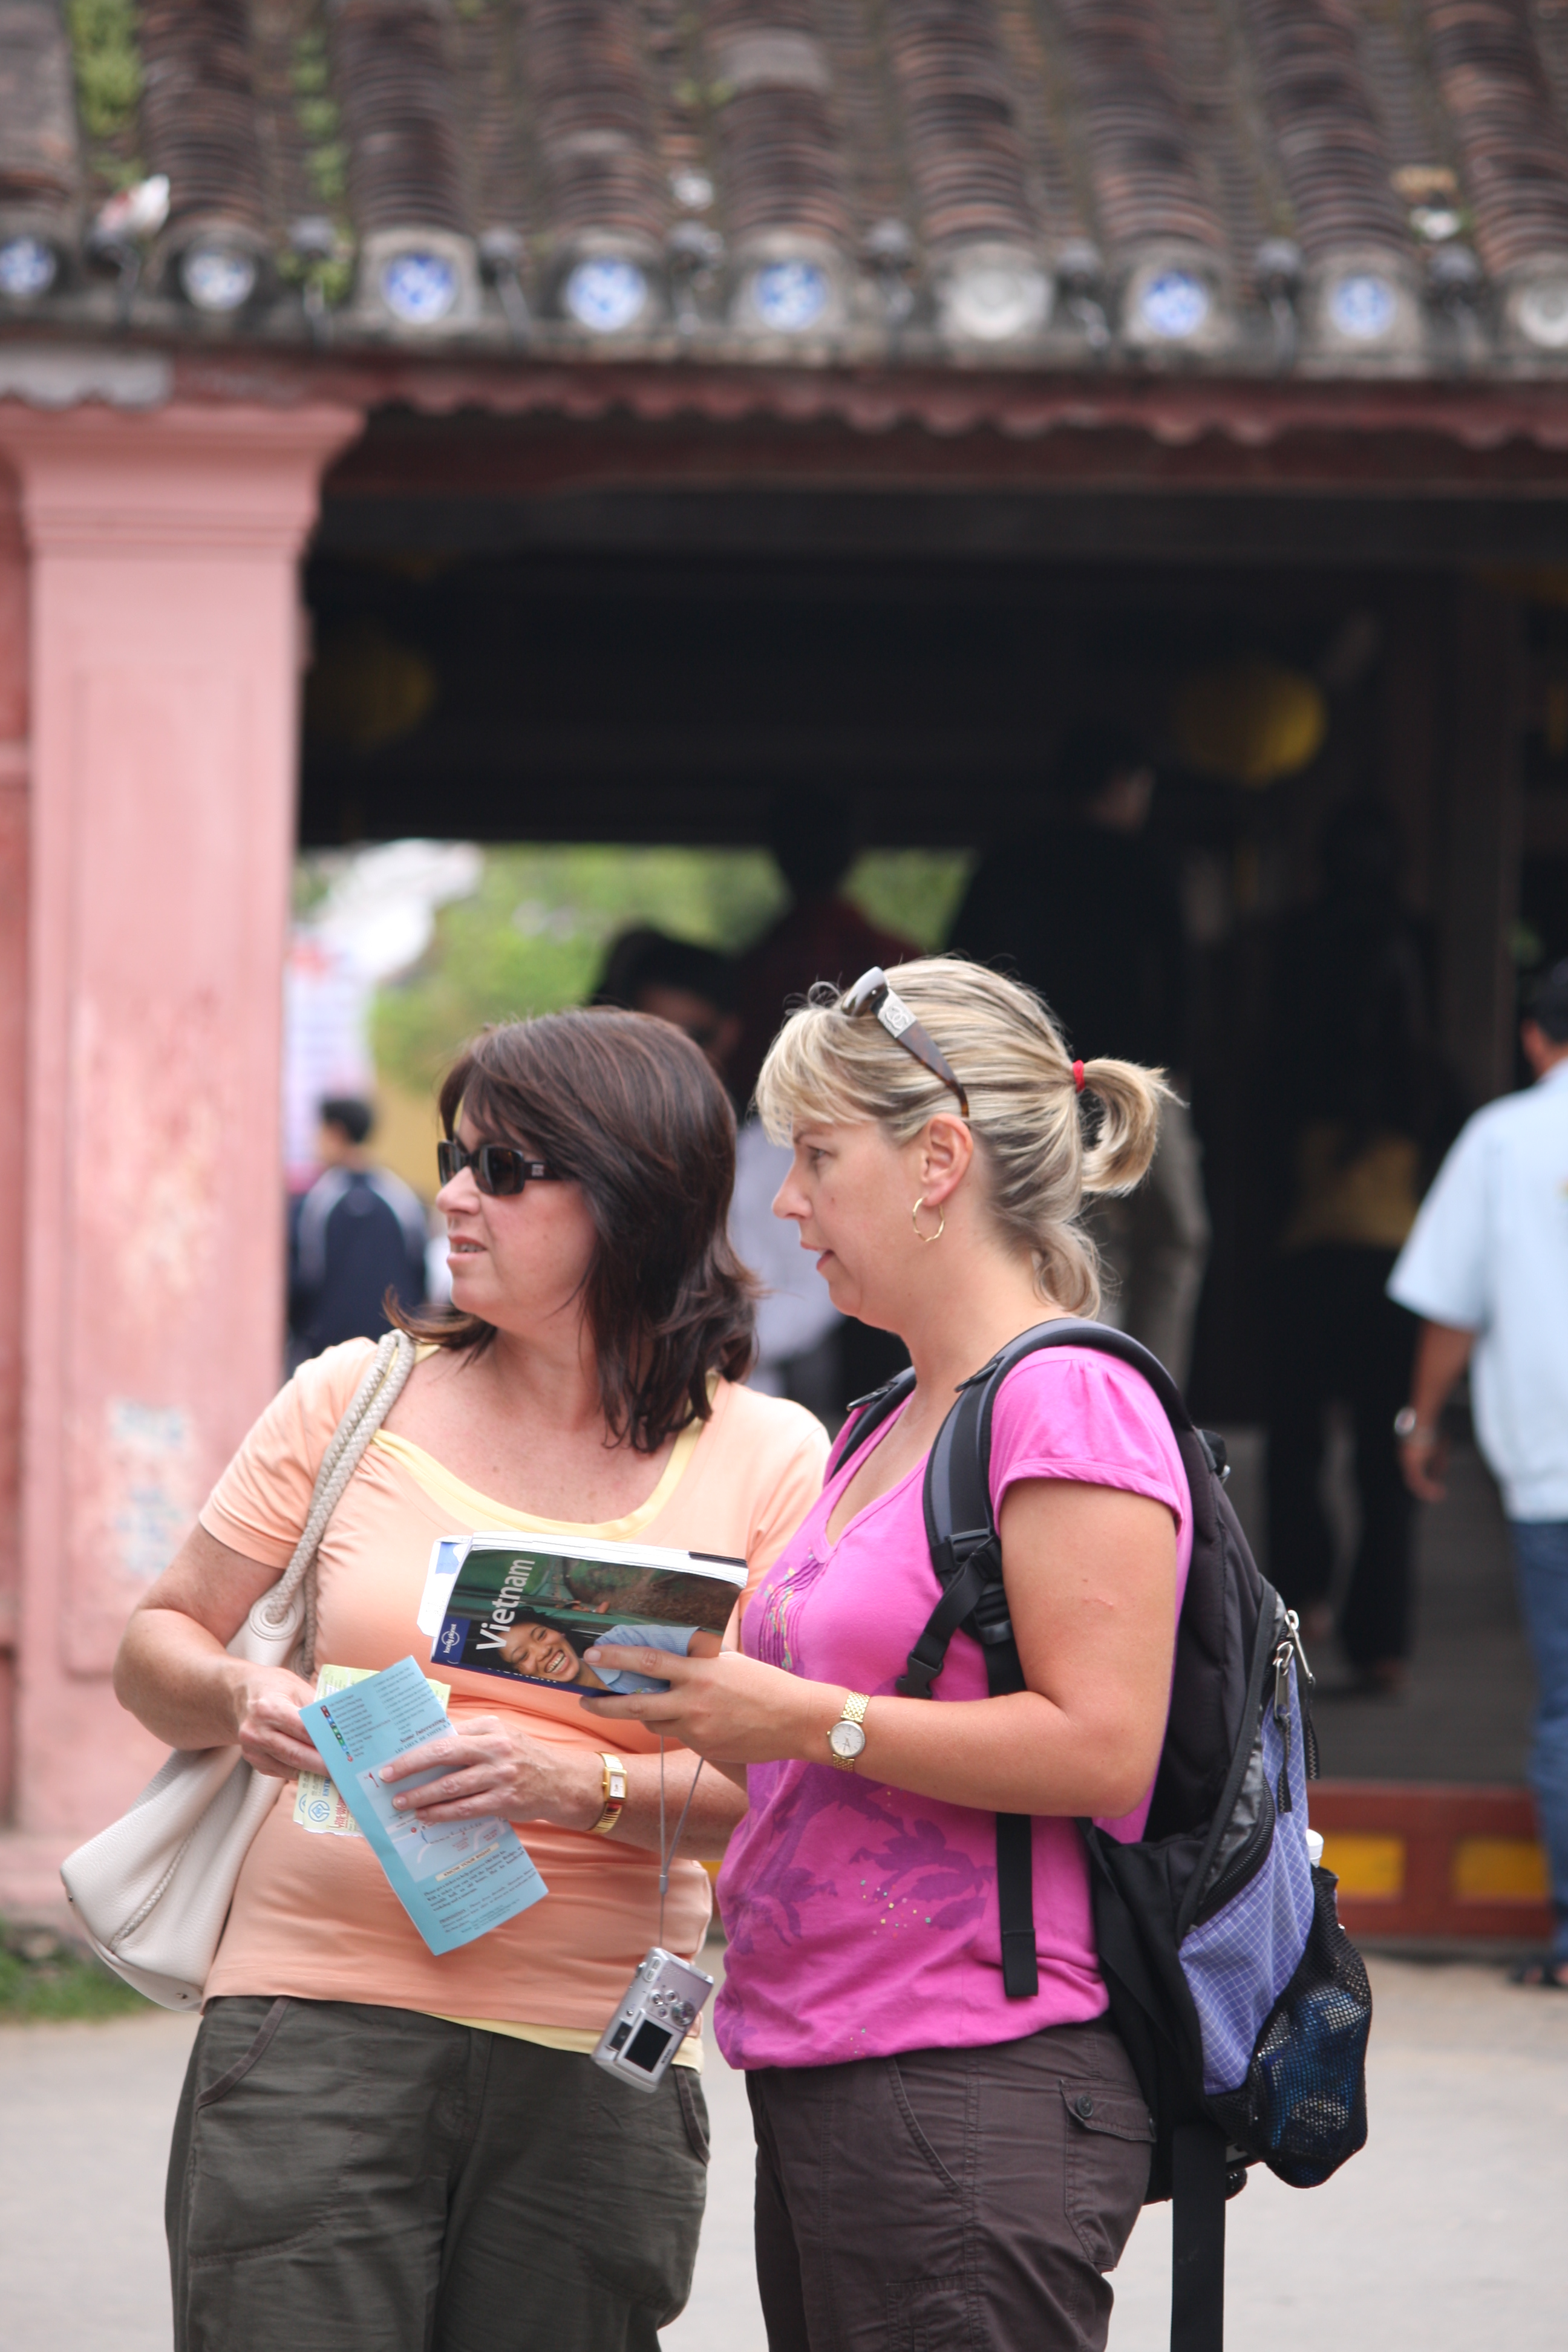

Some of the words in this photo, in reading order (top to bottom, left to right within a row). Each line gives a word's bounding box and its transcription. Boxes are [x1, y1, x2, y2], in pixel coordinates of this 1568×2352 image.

[475, 1559, 535, 1650] Vietnam
[443, 1638, 454, 1654] lonely
[449, 1624, 457, 1639] planet
[444, 1867, 459, 1875] KNOW
[475, 1849, 490, 1857] RIGHT
